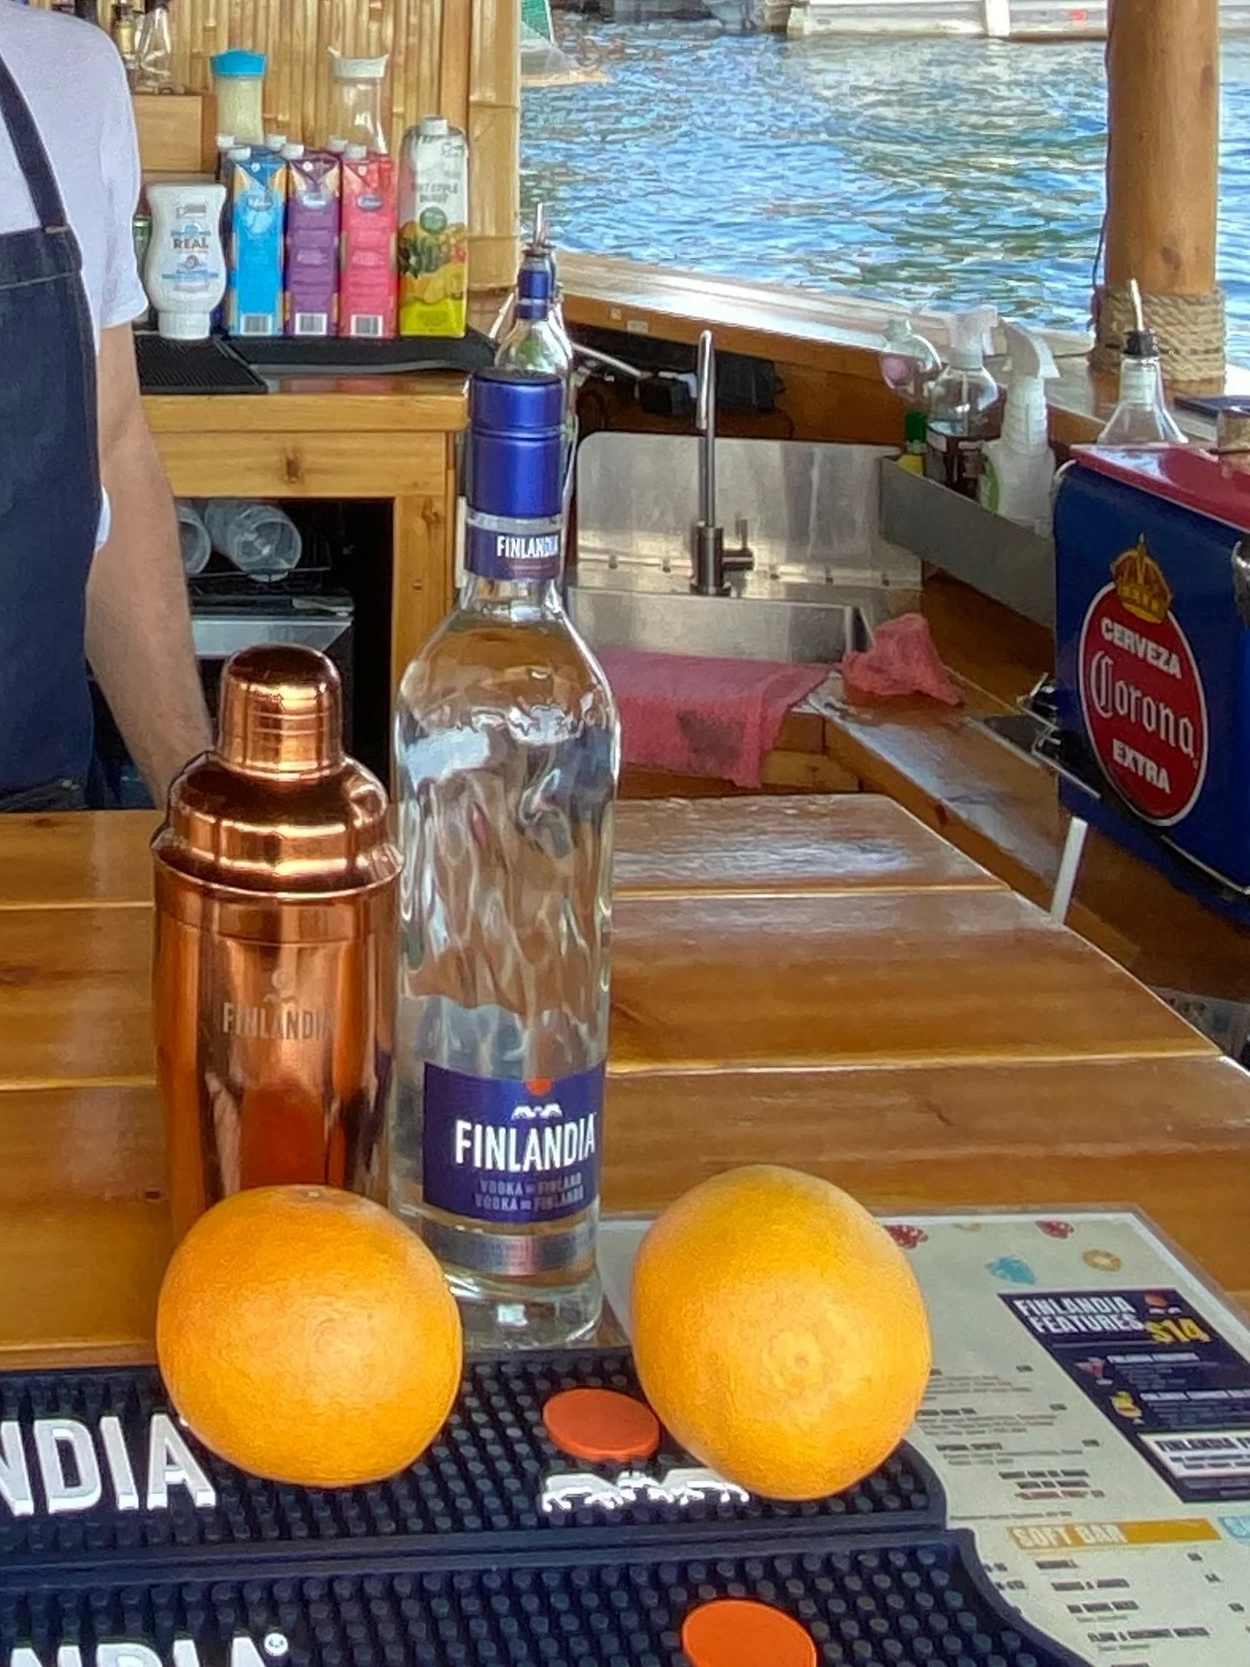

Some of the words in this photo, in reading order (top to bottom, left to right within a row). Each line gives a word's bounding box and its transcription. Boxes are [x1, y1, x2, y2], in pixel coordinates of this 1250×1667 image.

[173, 237, 209, 249] REAL
[1101, 616, 1182, 679] CERVEZA
[1091, 650, 1194, 759] Corona
[1112, 738, 1170, 794] EXTRA
[455, 1113, 596, 1172] FINLANDIA
[480, 1179, 523, 1196] VODKA
[475, 1194, 518, 1211] VODKA
[1014, 1296, 1137, 1316] FINLANDIA
[1029, 1314, 1145, 1334] FEATURES
[1143, 1318, 1213, 1343] $14
